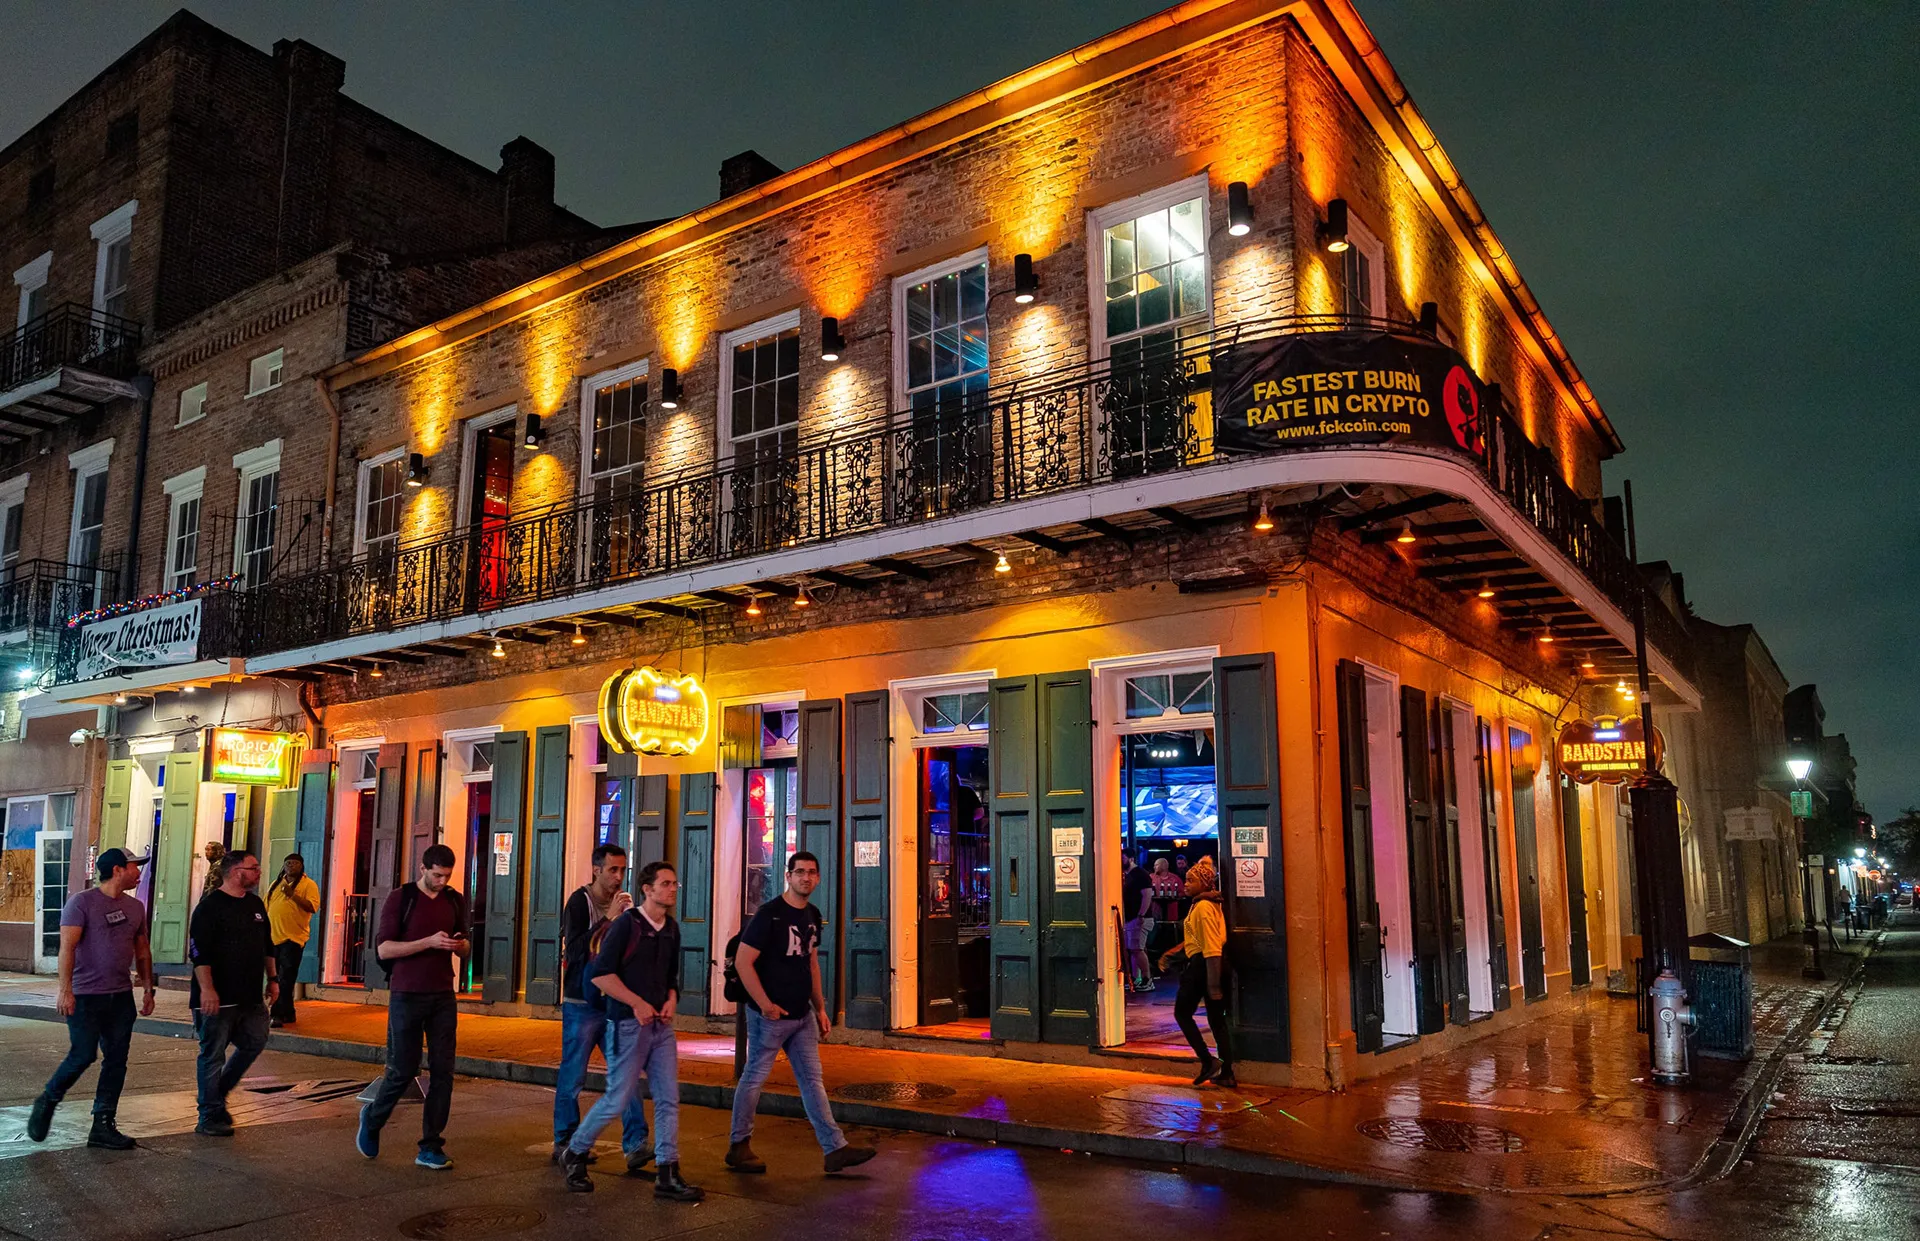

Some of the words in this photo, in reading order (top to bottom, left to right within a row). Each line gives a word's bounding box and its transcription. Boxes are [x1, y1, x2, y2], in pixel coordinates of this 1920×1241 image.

[1253, 371, 1359, 402] FASTEST
[1364, 370, 1421, 393] BURN
[1246, 398, 1309, 427] RATE
[1314, 395, 1340, 415] IN
[1345, 394, 1430, 417] CRYPTO
[1276, 418, 1411, 440] www.fckcoin.com
[82, 630, 118, 661] Merry
[116, 605, 199, 652] Christmas!
[630, 699, 705, 727] BANDSTAND
[238, 752, 265, 764] ISLE
[1562, 741, 1647, 762] BANDSTAN
[1059, 840, 1078, 848] ENTER
